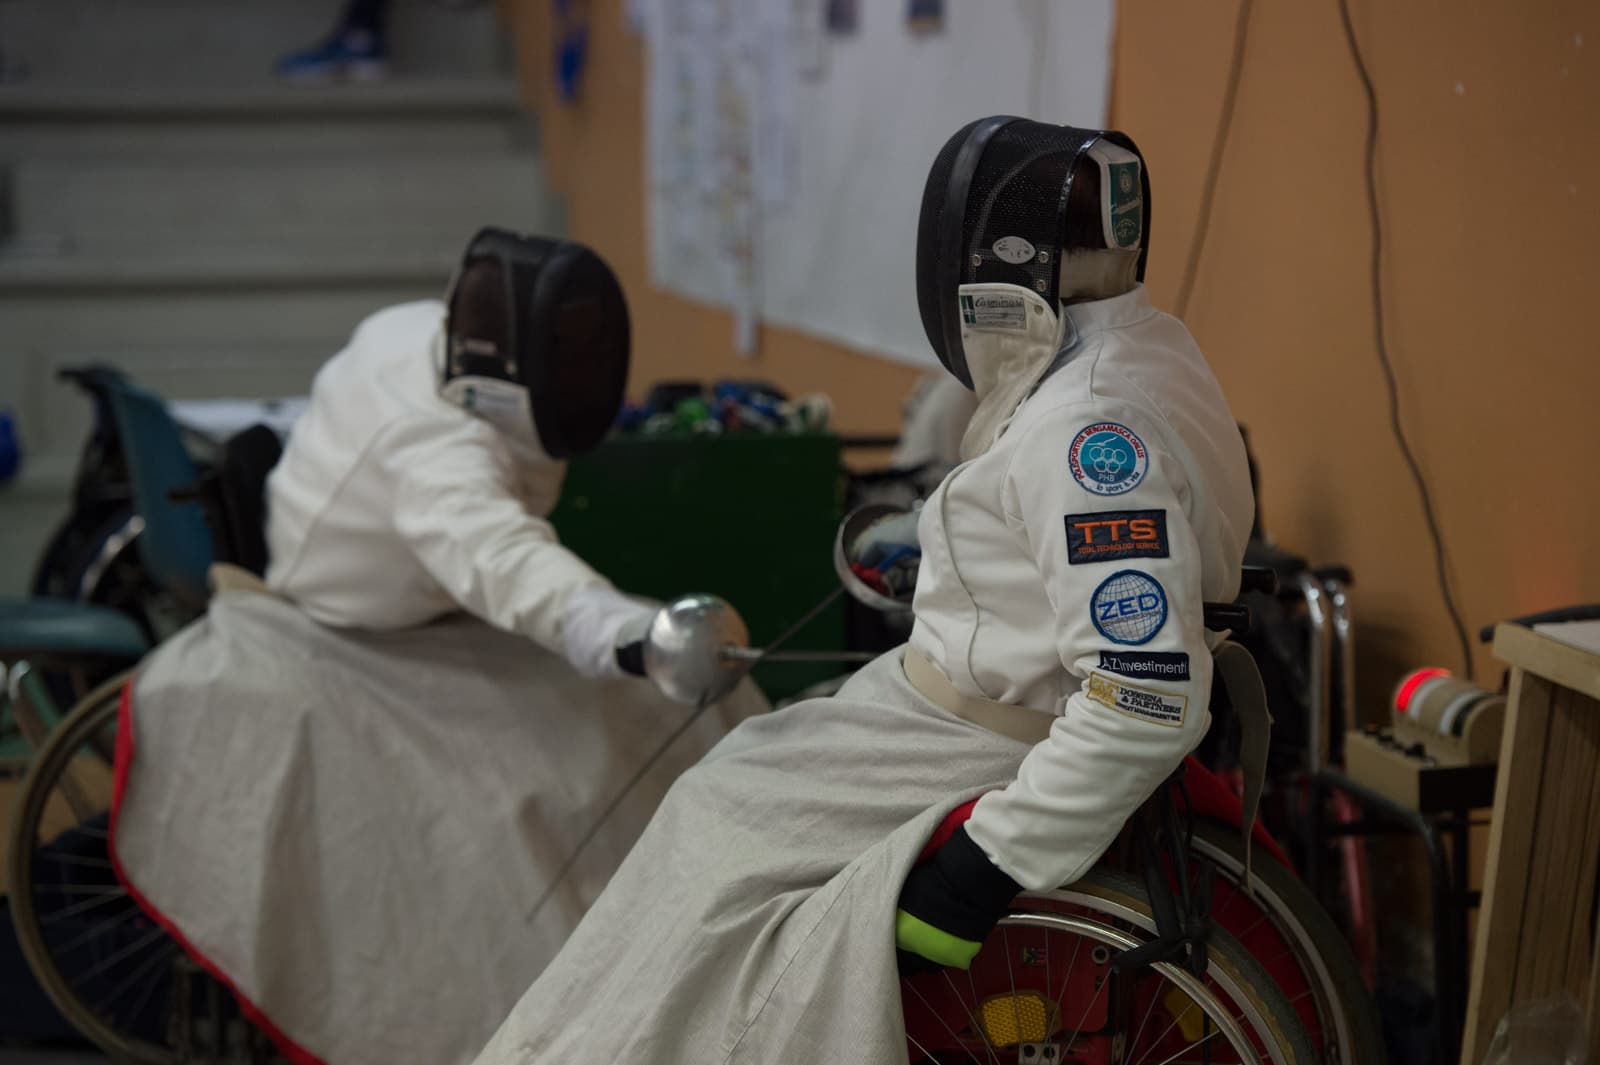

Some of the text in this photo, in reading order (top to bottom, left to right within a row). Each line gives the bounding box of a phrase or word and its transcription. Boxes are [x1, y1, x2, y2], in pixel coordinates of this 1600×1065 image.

[1085, 425, 1131, 440] BERGAMASCA
[1098, 473, 1115, 481] PHB
[1073, 519, 1158, 544] TTS
[1096, 543, 1133, 553] TECHNOLOGY
[1098, 593, 1159, 620] ZED
